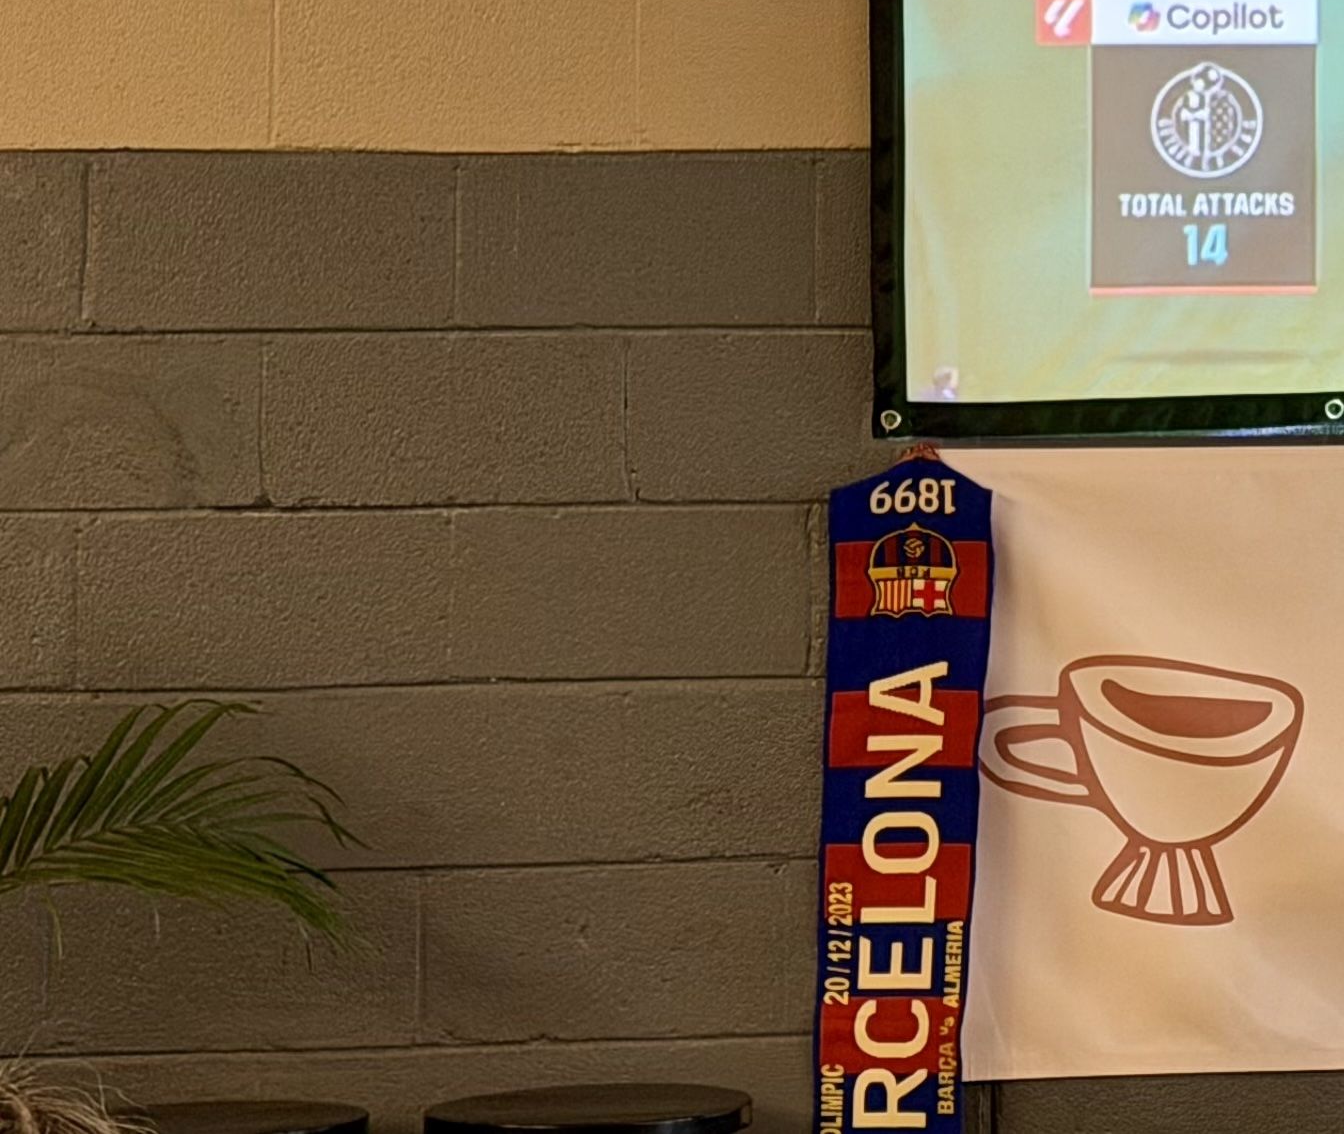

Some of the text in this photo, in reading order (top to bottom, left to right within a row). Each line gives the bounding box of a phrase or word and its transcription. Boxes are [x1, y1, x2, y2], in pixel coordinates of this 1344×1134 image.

[1166, 2, 1284, 35] Copilot
[1118, 192, 1295, 216] TOTAL ATTACKS
[1183, 223, 1228, 266] 14
[870, 477, 956, 515] 1899
[942, 920, 965, 1009] ALMERIA
